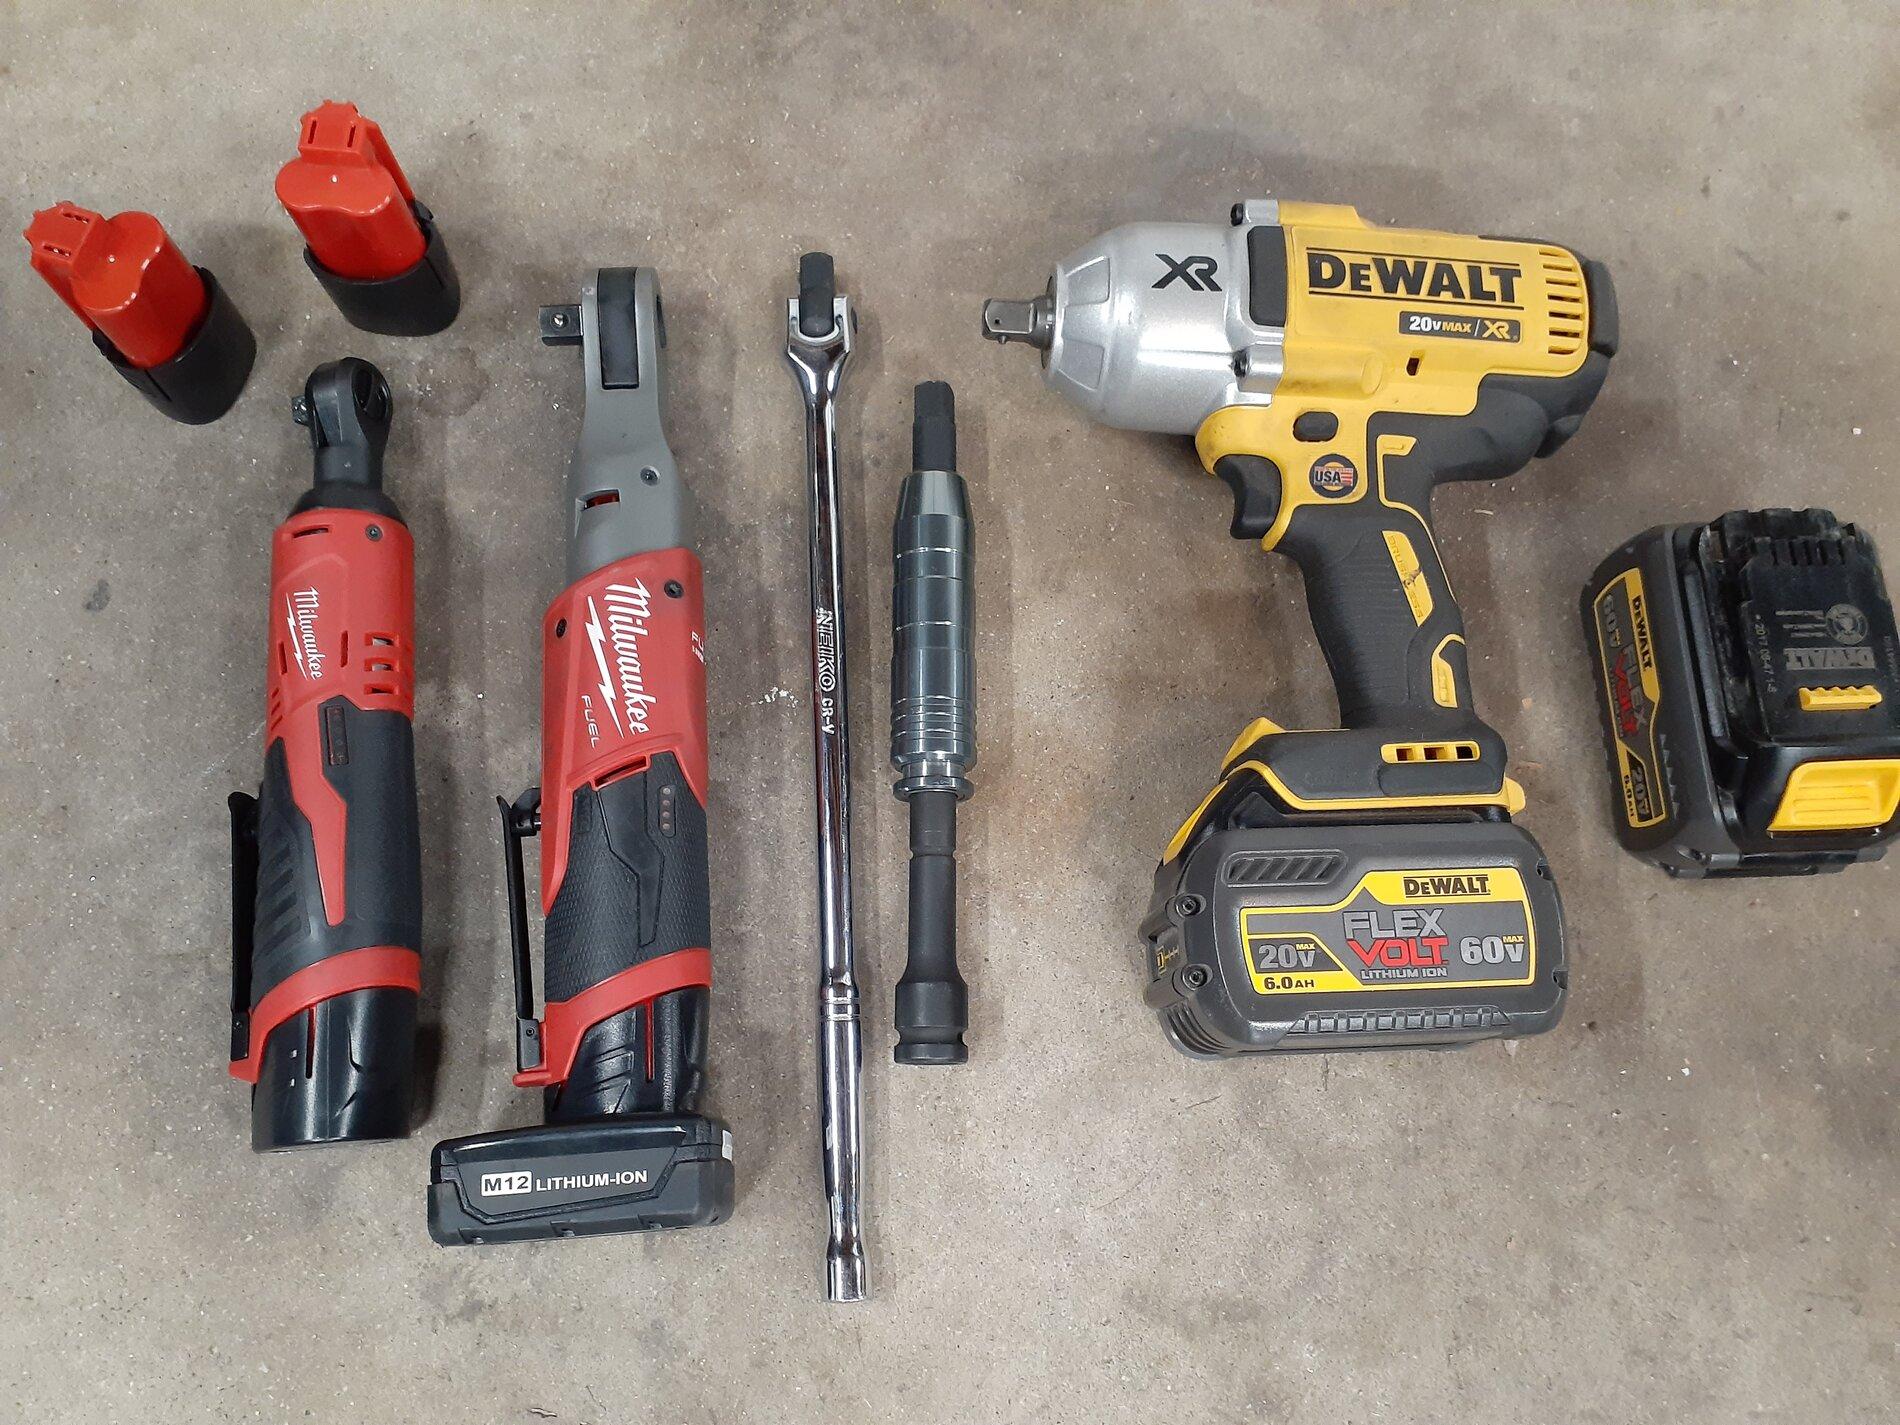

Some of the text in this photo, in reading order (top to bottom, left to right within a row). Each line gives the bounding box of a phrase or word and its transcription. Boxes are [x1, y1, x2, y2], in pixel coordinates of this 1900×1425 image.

[1151, 253, 1223, 292] XR
[1482, 319, 1511, 340] XR
[1315, 470, 1341, 483] USA
[293, 586, 325, 681] Milwaukee
[603, 578, 656, 736] Milwaukee
[815, 607, 836, 735] NEIKO CR-V
[581, 695, 600, 748] FUEL
[1342, 908, 1448, 940] FLEX
[1502, 935, 1525, 944] MAX
[1258, 943, 1316, 969] 20V
[1346, 937, 1449, 968] VOLT
[1361, 967, 1448, 980] LITHIUM ION
[484, 1170, 648, 1192] M12 LITHIUM-ION
